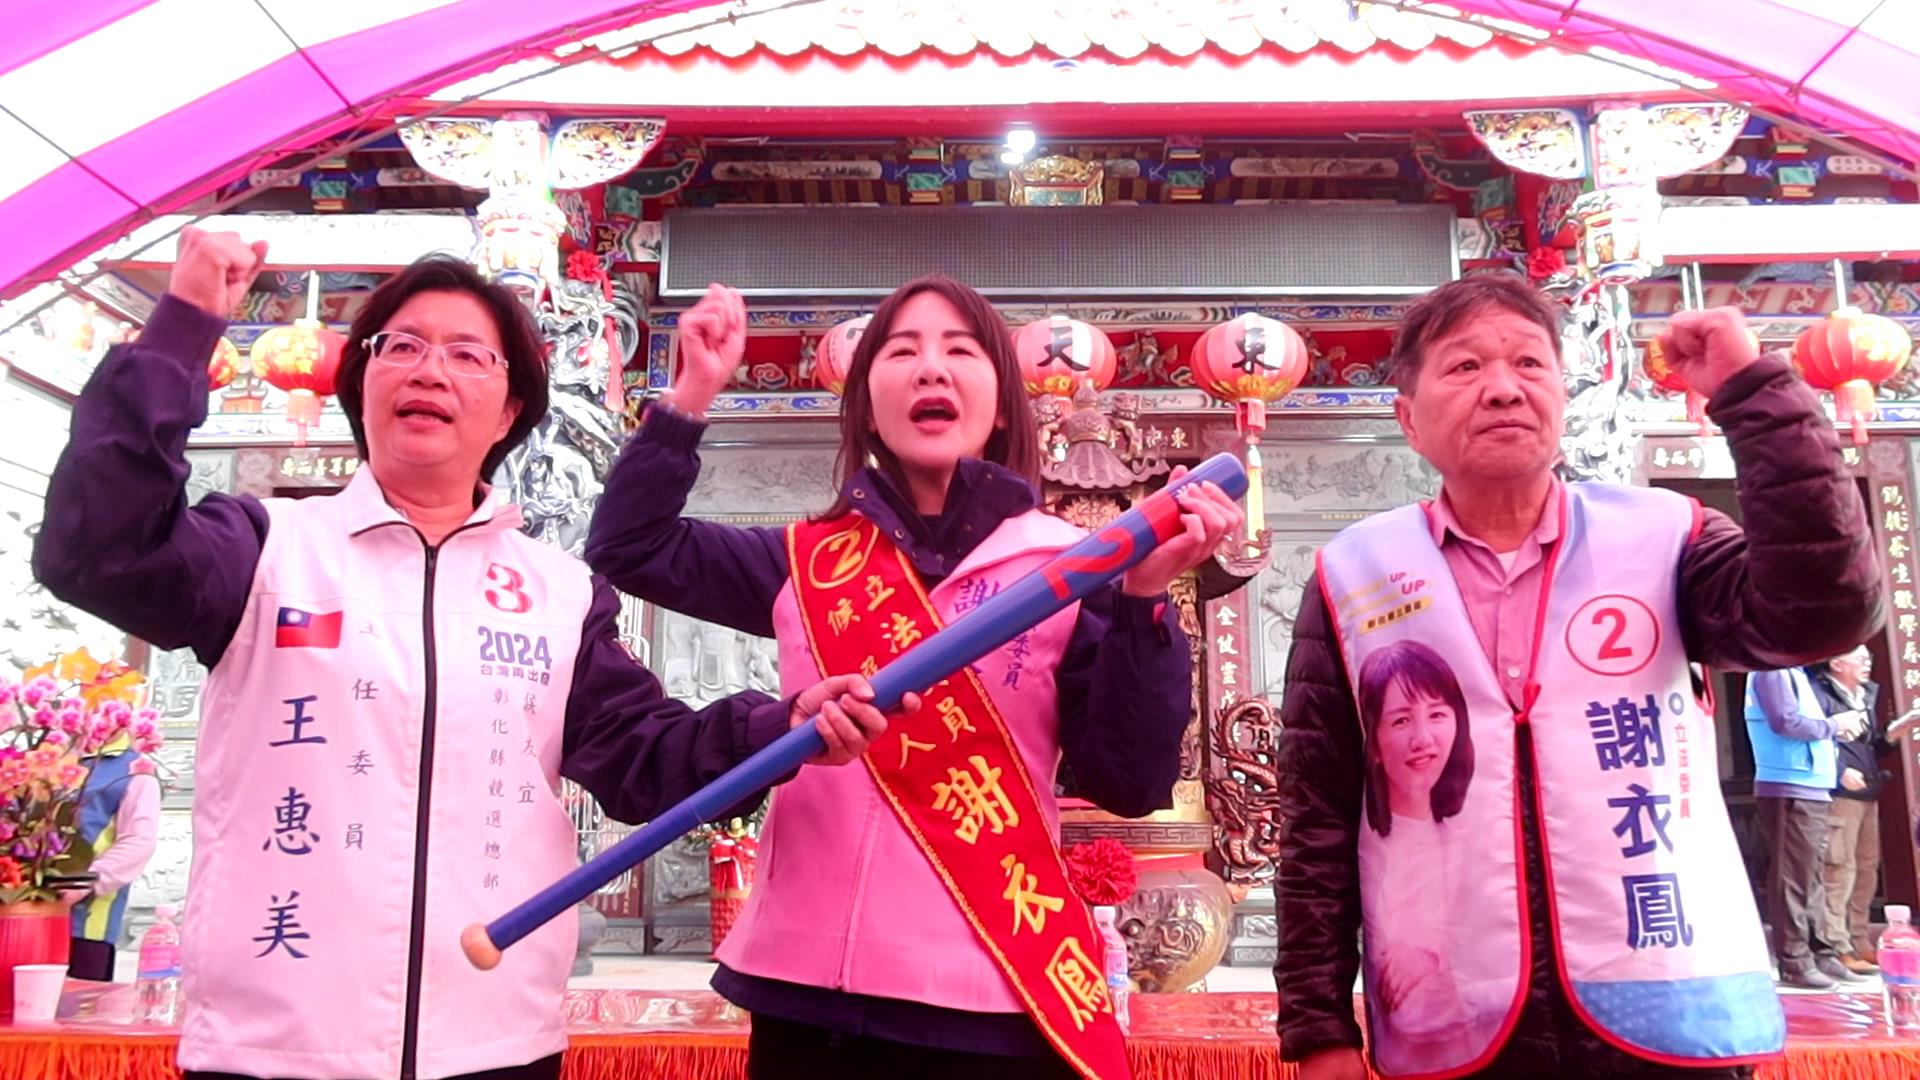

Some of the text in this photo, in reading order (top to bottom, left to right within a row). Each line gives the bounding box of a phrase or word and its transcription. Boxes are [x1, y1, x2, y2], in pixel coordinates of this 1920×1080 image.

[484, 562, 533, 614] 3
[1040, 527, 1136, 601] 2
[1389, 571, 1407, 583] UP
[1401, 579, 1426, 596] UP
[477, 625, 553, 671] 2024
[517, 691, 538, 805] 侯友宜
[252, 694, 328, 960] 王惠美
[1585, 693, 1694, 952] 謝衣鳳
[930, 754, 1113, 1033] 謝衣鳳
